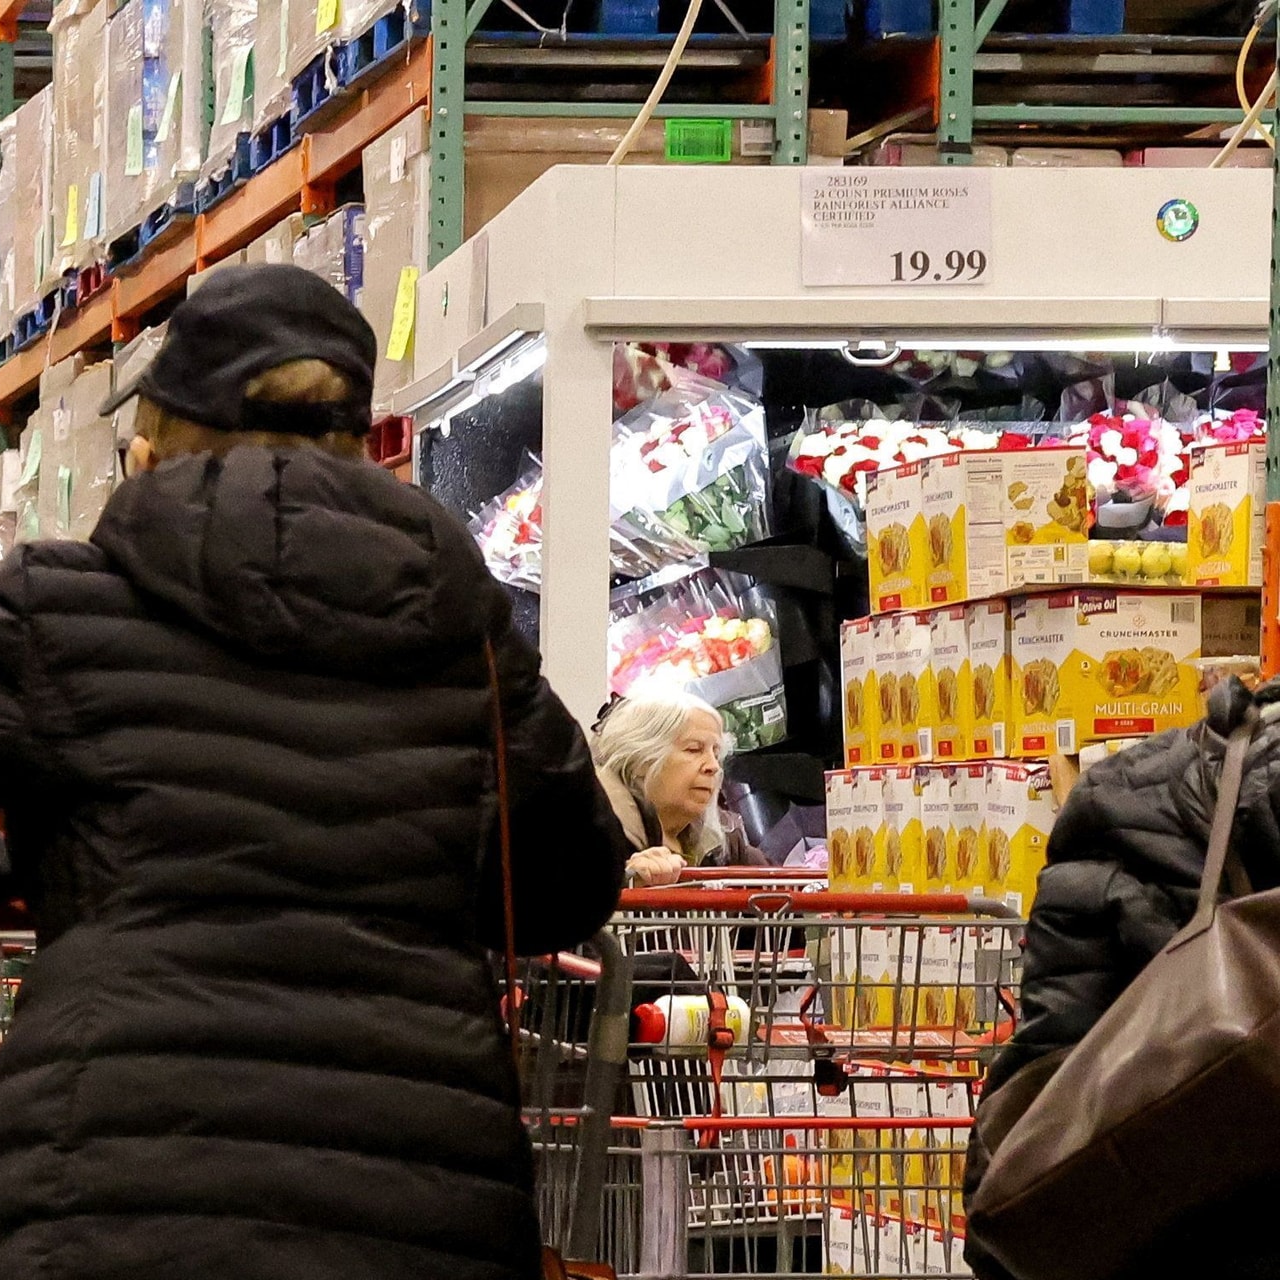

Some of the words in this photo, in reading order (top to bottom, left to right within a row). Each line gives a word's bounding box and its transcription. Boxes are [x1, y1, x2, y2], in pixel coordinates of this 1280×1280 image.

[828, 176, 867, 186] 283169
[814, 190, 825, 199] 24
[828, 189, 868, 198] COUNT
[874, 188, 929, 197] PREMIUM
[932, 187, 968, 197] ROSES
[814, 201, 885, 210] RAINFOREST
[890, 200, 949, 209] ALLIANCE
[814, 212, 875, 221] CERTIFIED
[890, 250, 987, 282] 19.99
[1195, 481, 1238, 494] CRUNCHMASTER
[871, 500, 910, 516] CRUNCHMASTER
[1081, 601, 1102, 613] Olive
[1104, 599, 1116, 611] Oil
[1018, 634, 1064, 645] CRUNCHMASTER
[1100, 630, 1178, 638] CRUNCHMASTER
[1095, 702, 1183, 715] MULTI-GRAIN
